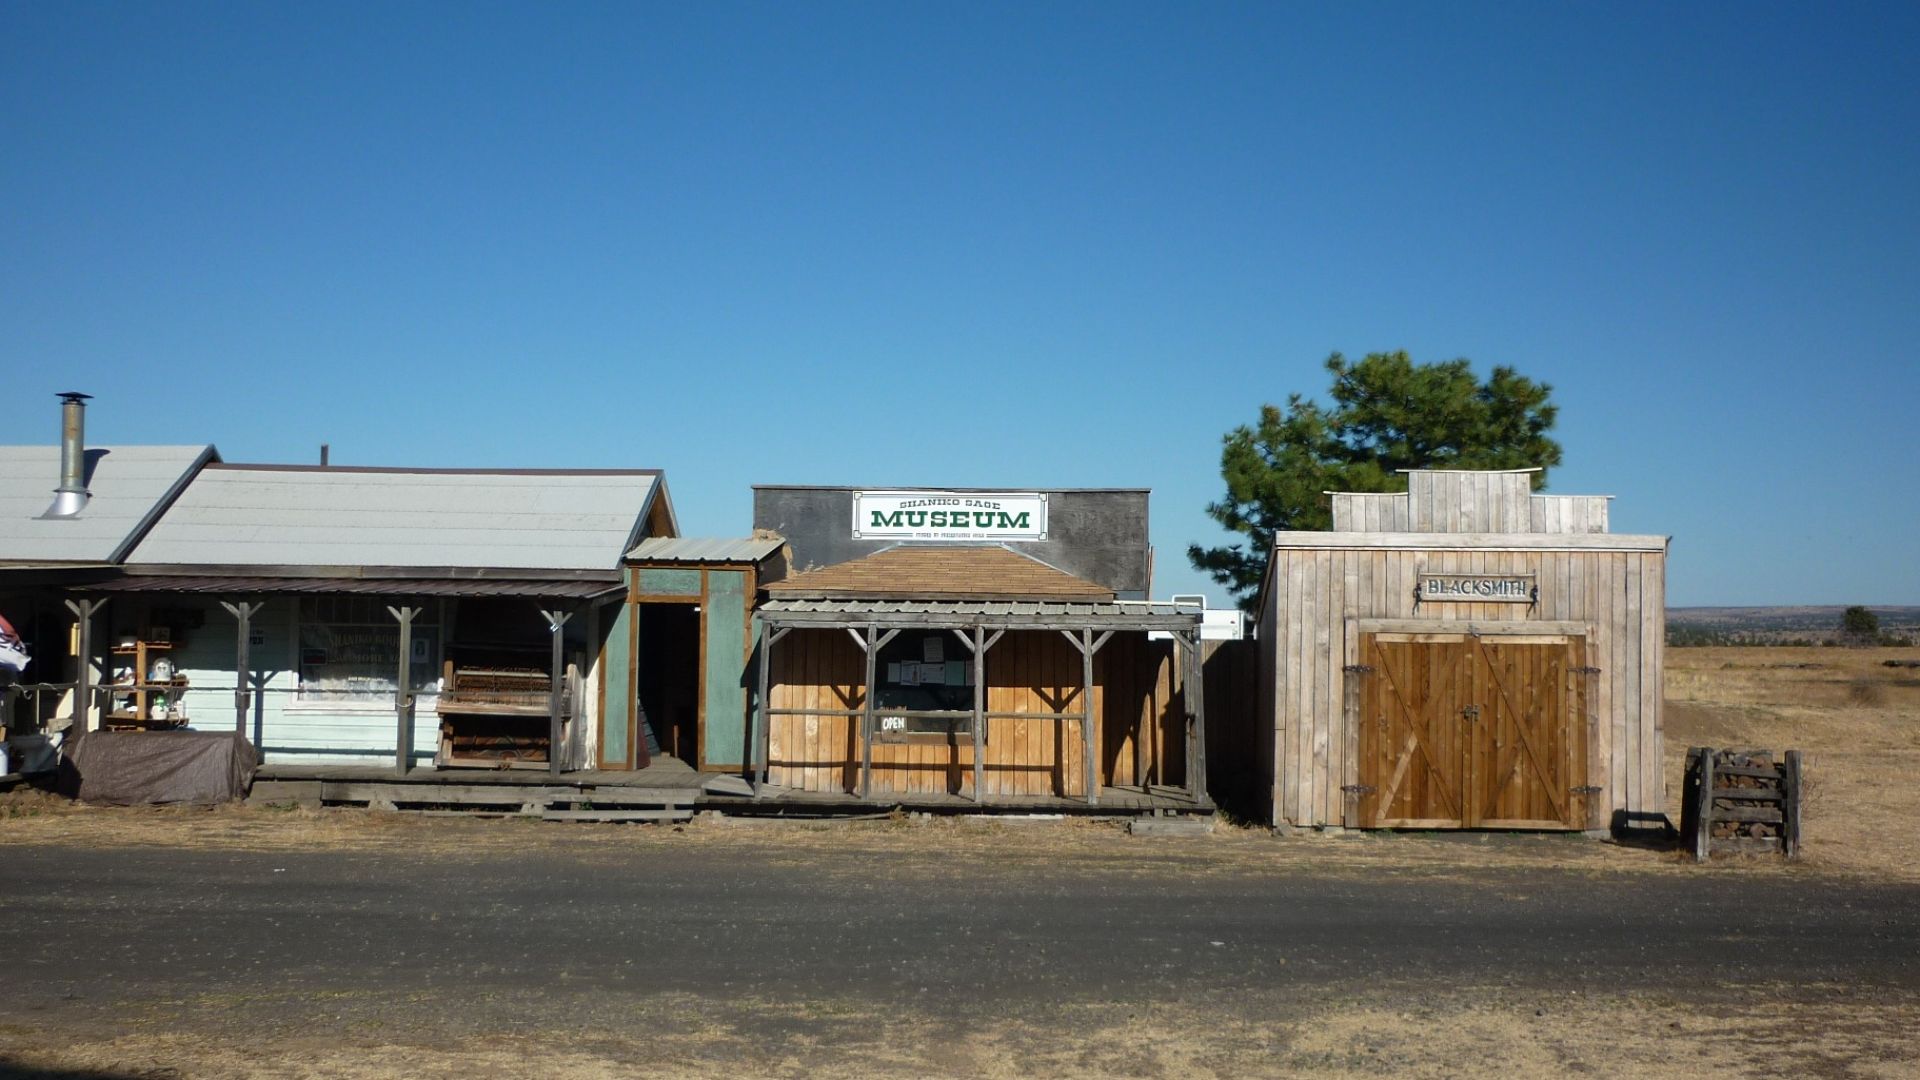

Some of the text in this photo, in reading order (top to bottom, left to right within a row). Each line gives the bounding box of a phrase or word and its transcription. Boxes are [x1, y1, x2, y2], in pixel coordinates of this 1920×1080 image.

[899, 498, 1001, 510] SHANIKO SAGE
[871, 510, 1030, 528] MUSEUM
[1426, 579, 1526, 598] BLACKSMITH
[883, 717, 904, 730] OPEN
